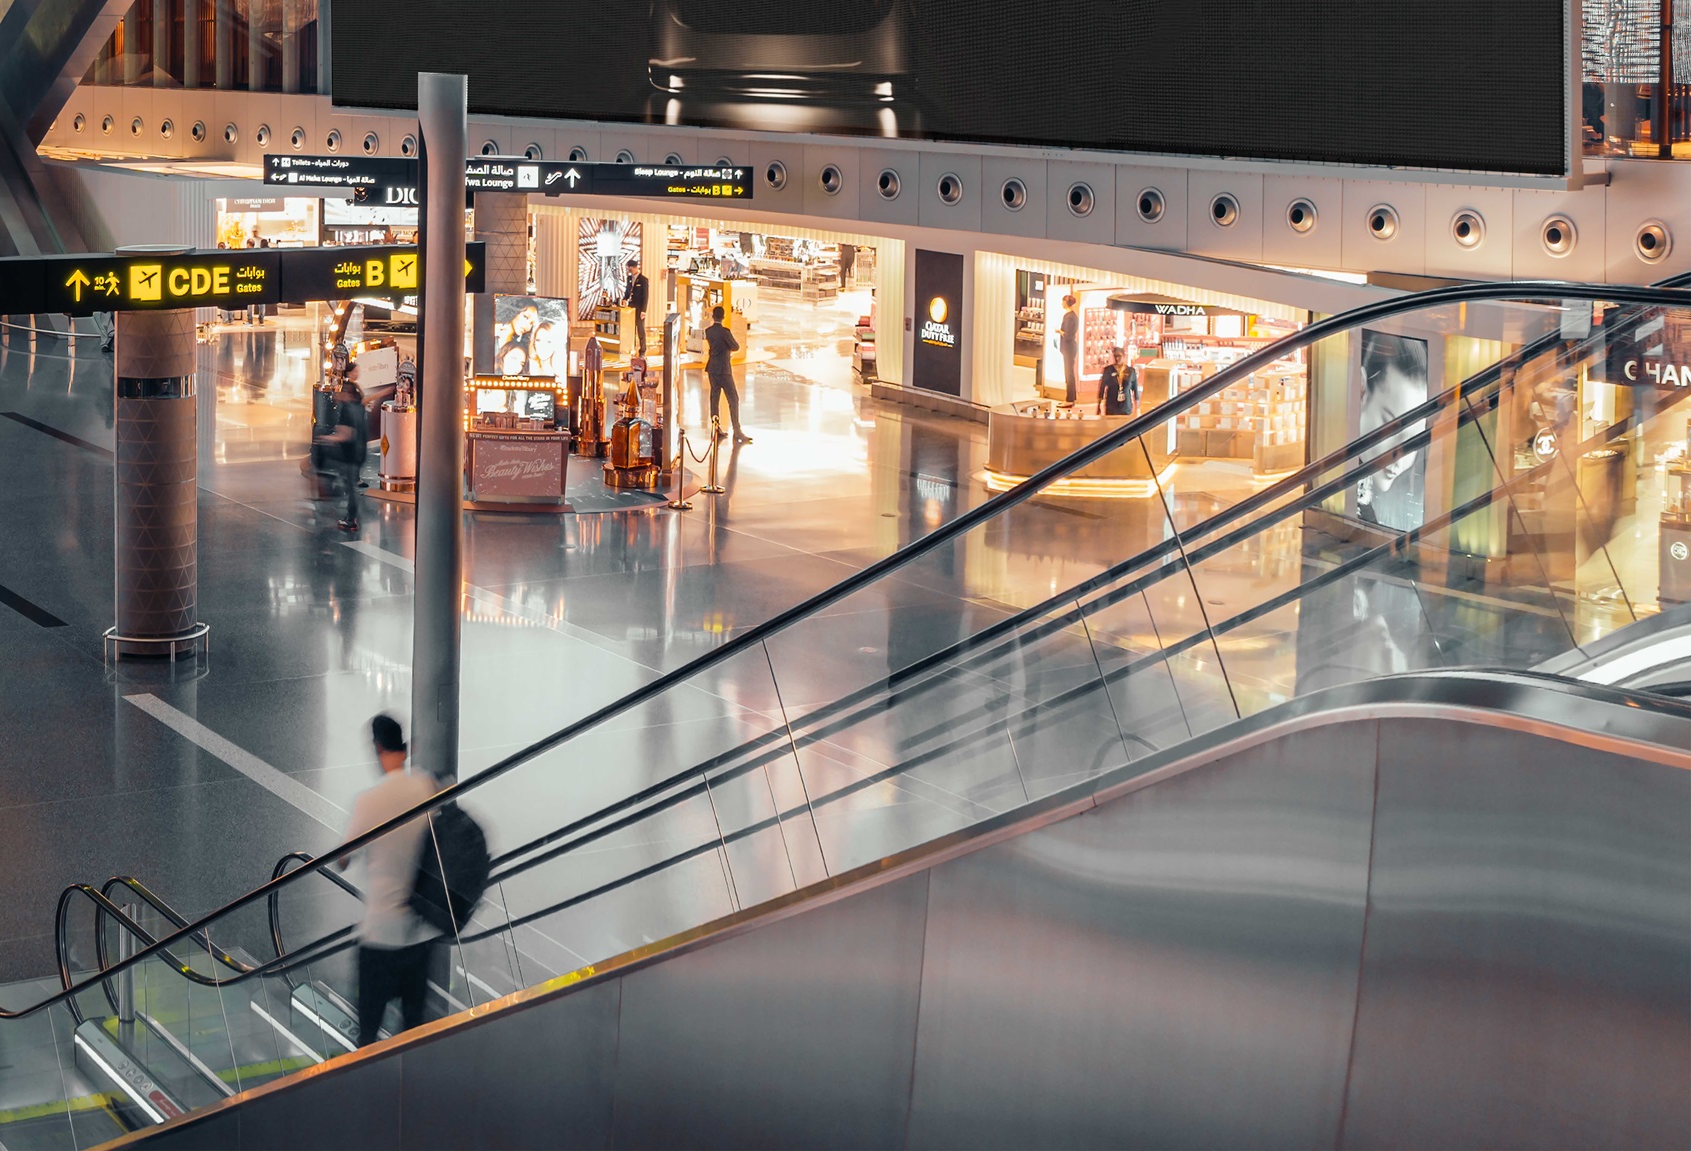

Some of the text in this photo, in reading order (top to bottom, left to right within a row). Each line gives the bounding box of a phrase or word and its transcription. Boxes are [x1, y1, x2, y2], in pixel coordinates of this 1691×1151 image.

[491, 165, 514, 176] صالة
[654, 168, 678, 178] Lounge
[482, 178, 514, 189] Lounge
[712, 185, 721, 196] B
[236, 266, 265, 279] بوابات
[334, 262, 361, 274] بوابات
[366, 260, 384, 286] B
[94, 277, 104, 285] 10
[169, 267, 230, 296] CDE
[337, 279, 360, 288] Gates
[236, 284, 262, 293] Gates
[1155, 305, 1206, 315] WADHA
[925, 321, 949, 334] QATAR
[921, 329, 940, 340] DUTY
[480, 464, 521, 481] Beauty
[522, 458, 555, 474] Wishes
